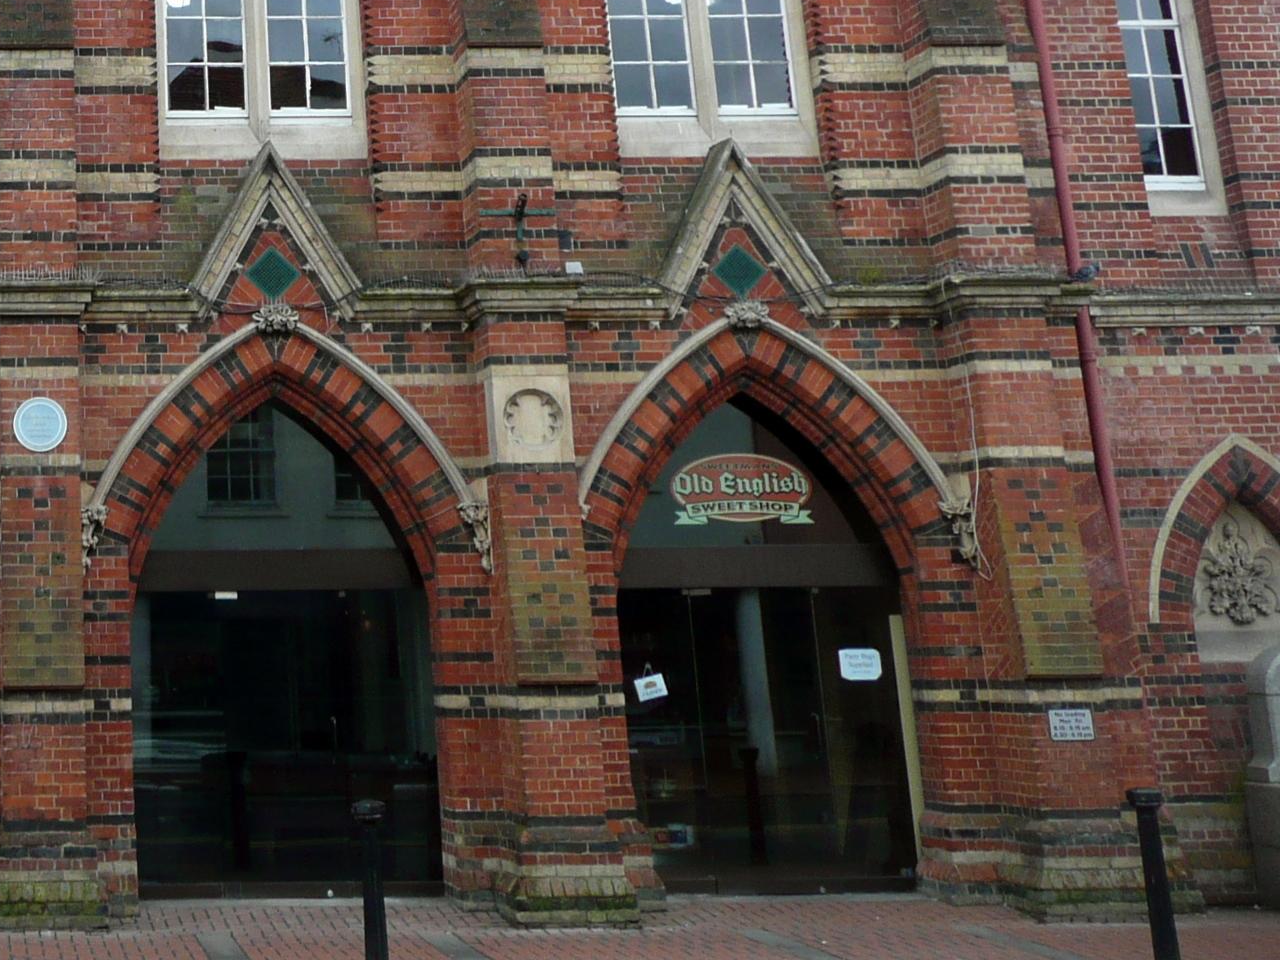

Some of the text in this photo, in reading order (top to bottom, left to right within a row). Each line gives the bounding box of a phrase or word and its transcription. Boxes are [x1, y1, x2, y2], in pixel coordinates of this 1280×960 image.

[673, 471, 808, 497] Old English
[691, 500, 795, 514] SWEET SHOP
